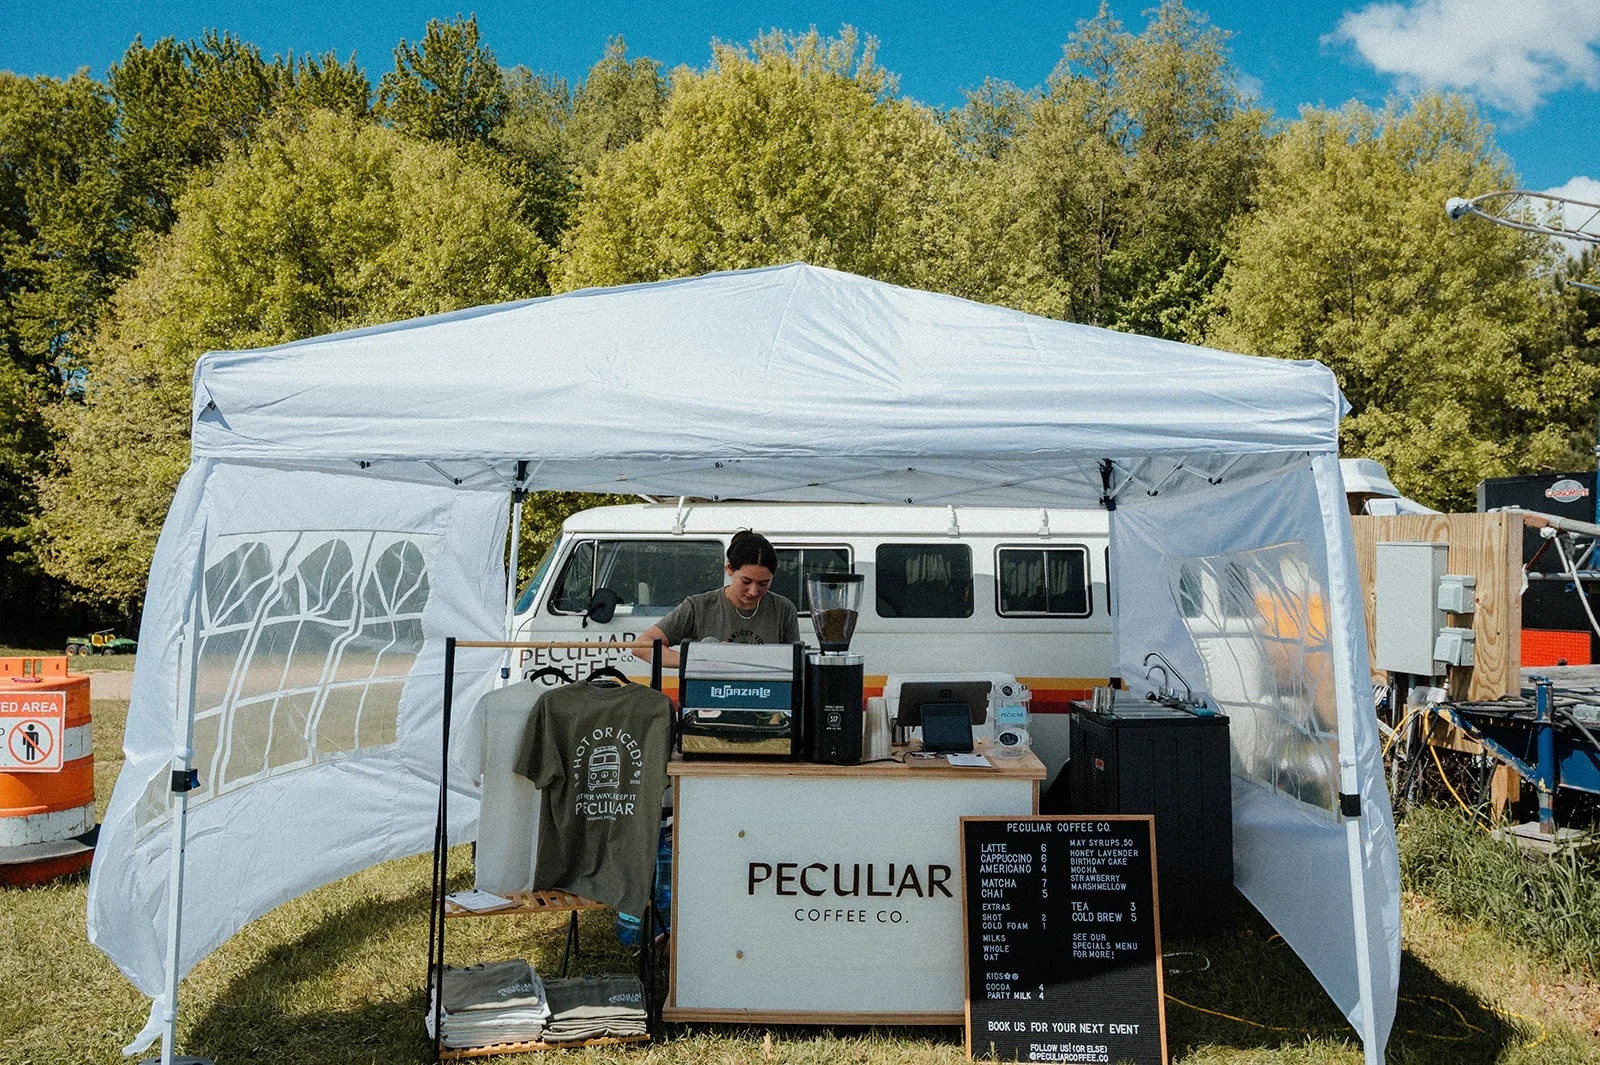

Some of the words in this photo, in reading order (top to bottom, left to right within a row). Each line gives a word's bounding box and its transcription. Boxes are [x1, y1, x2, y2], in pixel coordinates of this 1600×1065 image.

[0, 702, 18, 712] ED
[22, 702, 58, 712] AREA
[573, 736, 590, 768] HOT
[592, 727, 612, 740] OR
[616, 728, 642, 767] ICED?
[576, 801, 634, 816] PECULIAR
[1007, 823, 1052, 832] PECULIAR
[1057, 824, 1093, 832] COFFEE
[1097, 824, 1110, 832] CO.
[981, 844, 1006, 852] LATTE
[1041, 844, 1047, 852] 6
[981, 854, 1032, 863] CAPPUCCINO
[1041, 854, 1047, 863] 6
[980, 865, 1032, 873] AMERICANO
[1041, 865, 1047, 873] 4
[748, 863, 954, 898] PECULIAR
[982, 879, 1016, 888] MATCHA
[1042, 879, 1047, 888] 7
[981, 889, 1003, 898] CHAI
[1042, 890, 1048, 898] 5
[1071, 902, 1089, 911] TEA
[1130, 902, 1136, 911] 3
[794, 909, 866, 922] COFFEE
[877, 910, 909, 923] CO.
[1072, 913, 1094, 922] COLD
[1097, 913, 1122, 922] BREW
[1131, 913, 1137, 921] 5
[1089, 951, 1115, 959] MORE!
[988, 1021, 1010, 1031] BOOK
[1014, 1022, 1025, 1031] US
[1031, 1022, 1048, 1032] FOR
[1052, 1023, 1076, 1032] YOUR
[1080, 1024, 1104, 1033] NEXT
[1110, 1024, 1139, 1034] EVENT
[1060, 1043, 1071, 1052] US!
[1087, 1045, 1107, 1053] ELSE)
[1029, 1052, 1108, 1062] @PECULIARCOFFEE.CO
